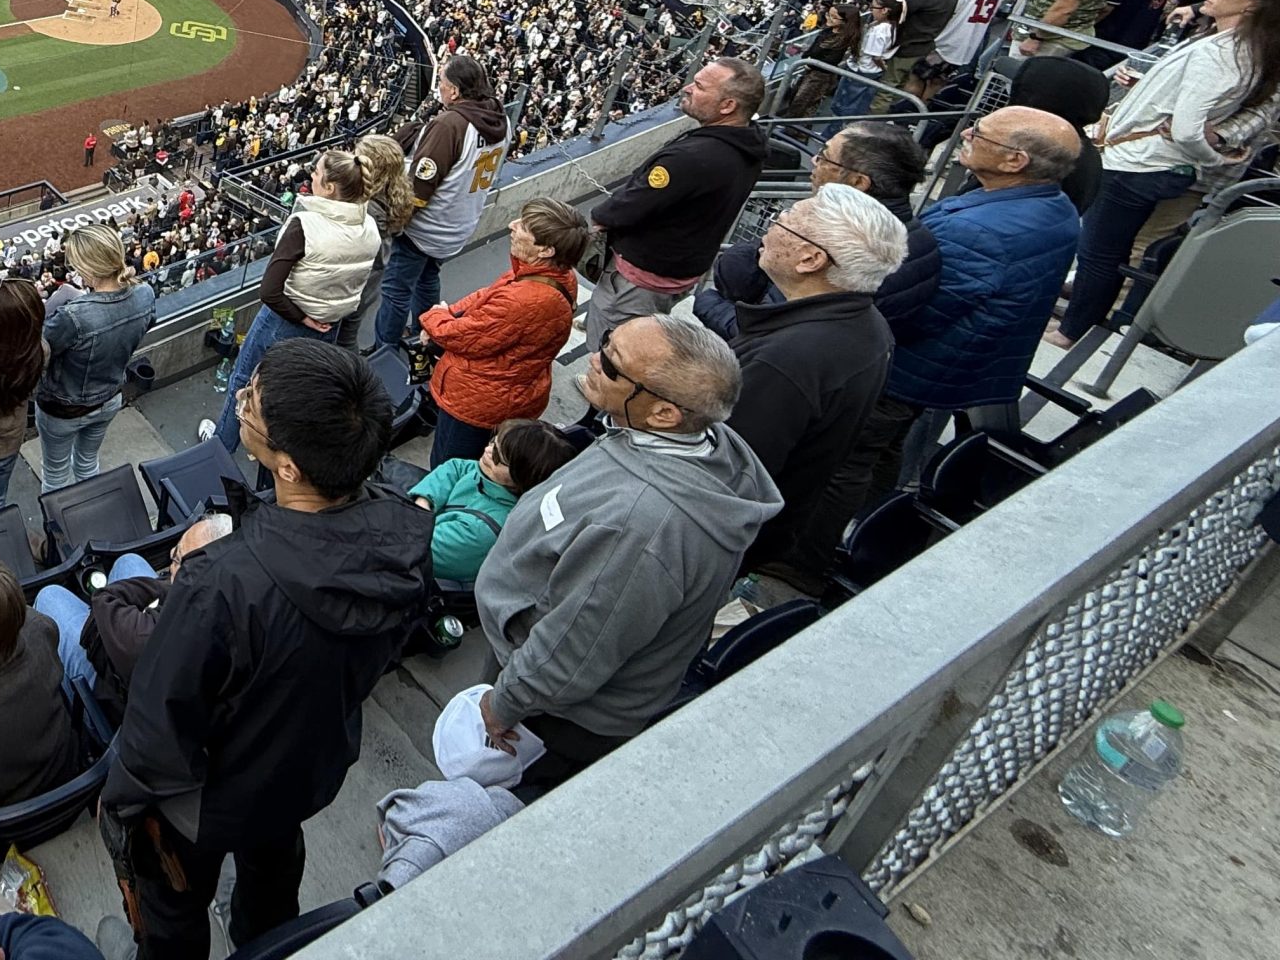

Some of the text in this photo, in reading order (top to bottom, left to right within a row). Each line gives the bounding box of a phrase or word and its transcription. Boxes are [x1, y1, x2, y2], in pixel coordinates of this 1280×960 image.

[470, 149, 503, 193] 19
[20, 196, 148, 247] petco park
